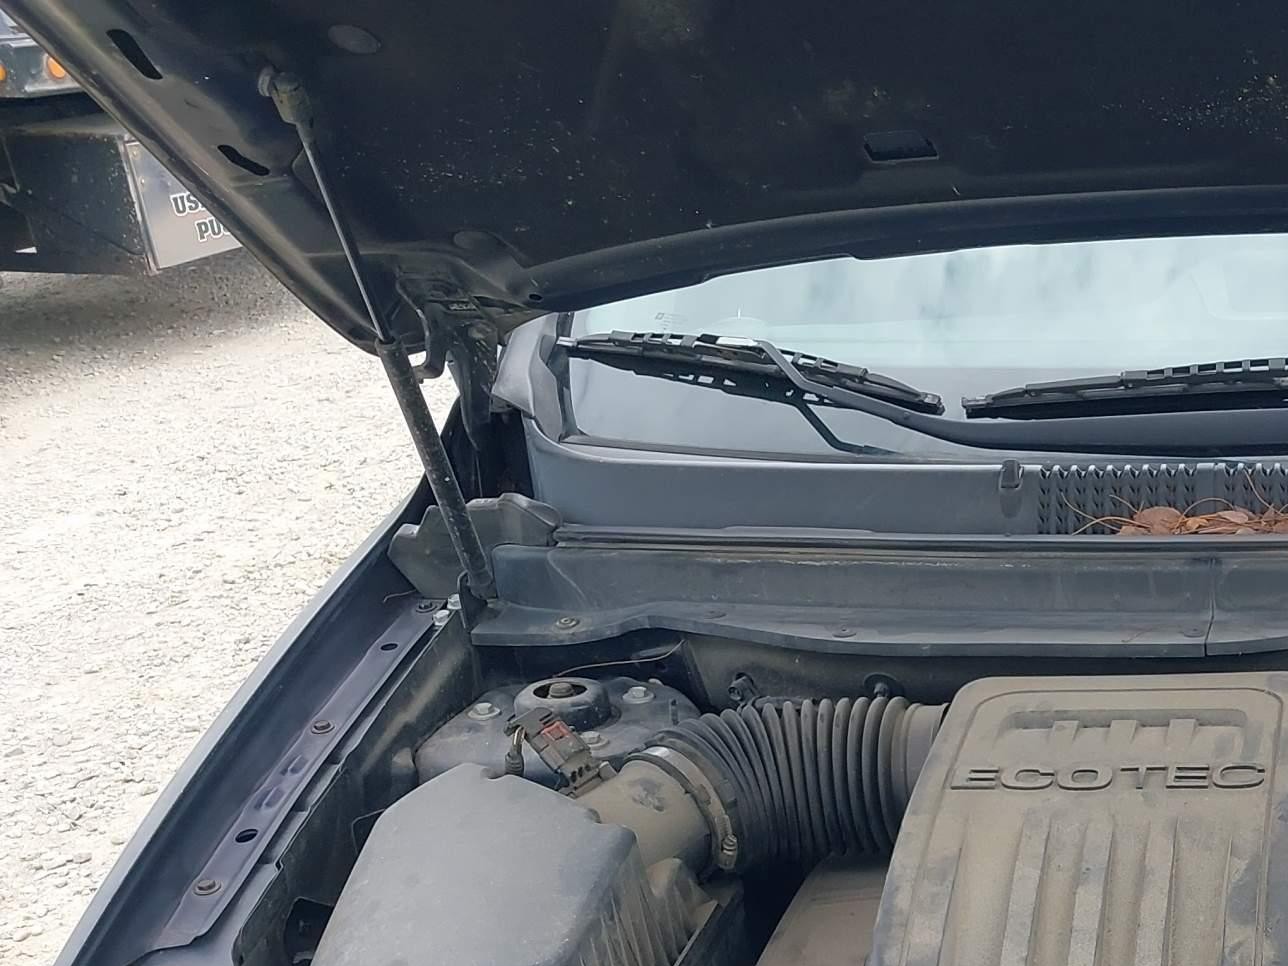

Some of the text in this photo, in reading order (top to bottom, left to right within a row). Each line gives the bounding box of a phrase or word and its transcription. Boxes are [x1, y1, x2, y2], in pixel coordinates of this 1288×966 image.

[170, 192, 205, 216] US
[195, 216, 230, 242] PU
[950, 764, 1265, 790] ECOTEC
